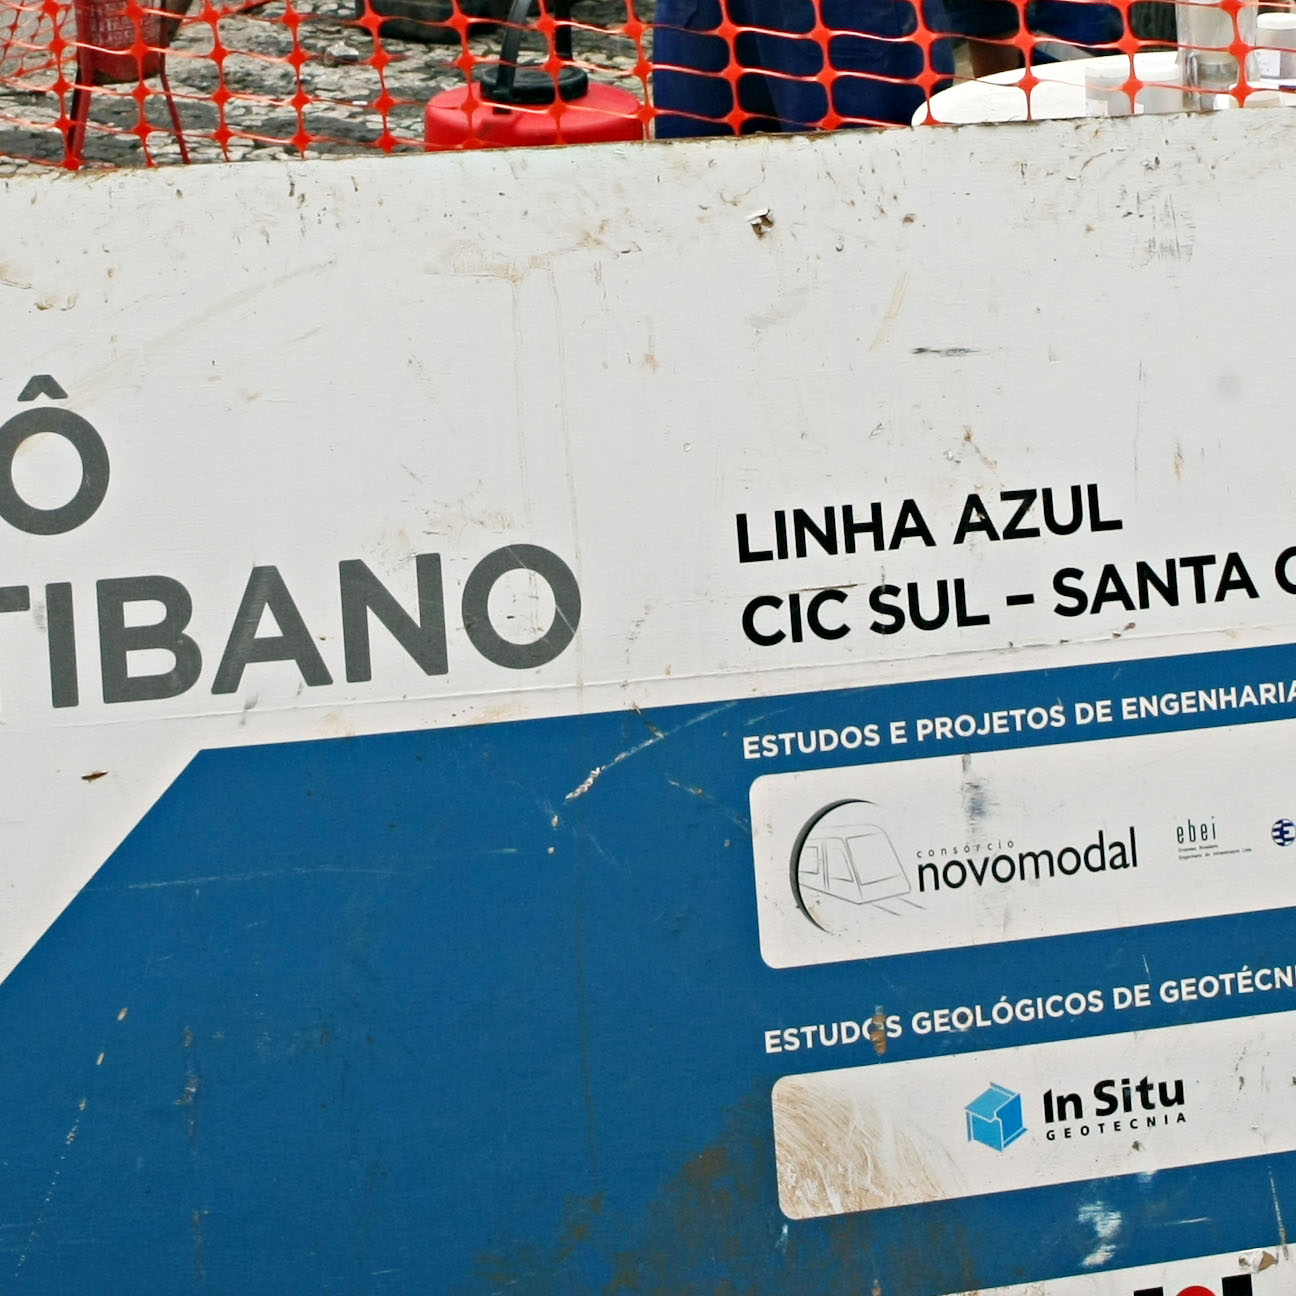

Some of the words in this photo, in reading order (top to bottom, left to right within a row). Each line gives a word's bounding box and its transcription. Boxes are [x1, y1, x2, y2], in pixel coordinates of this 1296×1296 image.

[736, 498, 937, 563] LINHA
[953, 483, 1123, 545] AZUL
[741, 588, 851, 647] CIC
[868, 577, 991, 635] SUL
[1052, 551, 1260, 617] SANTA
[742, 723, 881, 760] ESTUDOS
[889, 720, 908, 745] E
[916, 704, 1066, 741] PROJETOS
[1075, 699, 1113, 725] DE
[916, 839, 1015, 859] consórcio
[917, 825, 1138, 893] novomodal
[1176, 815, 1216, 844] ebei
[764, 1014, 903, 1054] ESTUDOS
[911, 995, 1105, 1035] GEOLÓGICOS
[1113, 983, 1152, 1010] DE
[1042, 1087, 1084, 1124] In
[1093, 1075, 1186, 1117] Situ
[1045, 1111, 1187, 1141] GEOTECNIA
